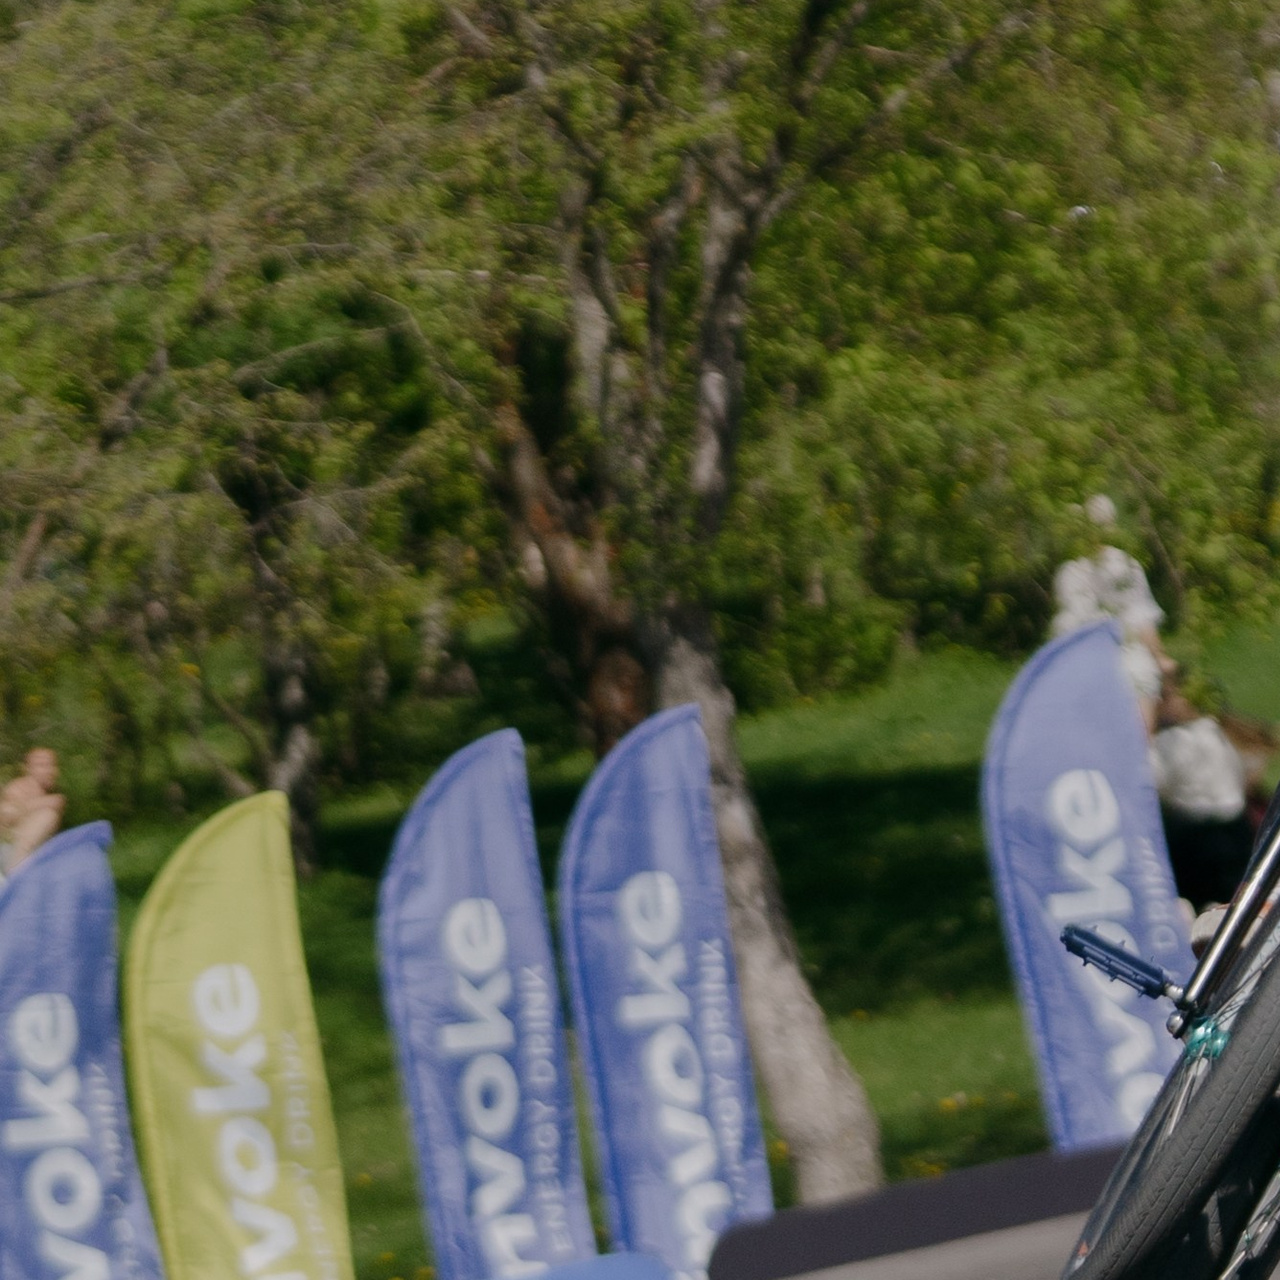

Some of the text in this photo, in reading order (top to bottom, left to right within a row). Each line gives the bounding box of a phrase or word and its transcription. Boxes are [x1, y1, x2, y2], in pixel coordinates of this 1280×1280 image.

[440, 897, 550, 1280] nvoke
[520, 963, 575, 1253] ENERGY DRINK
[698, 938, 737, 1062] DRINK
